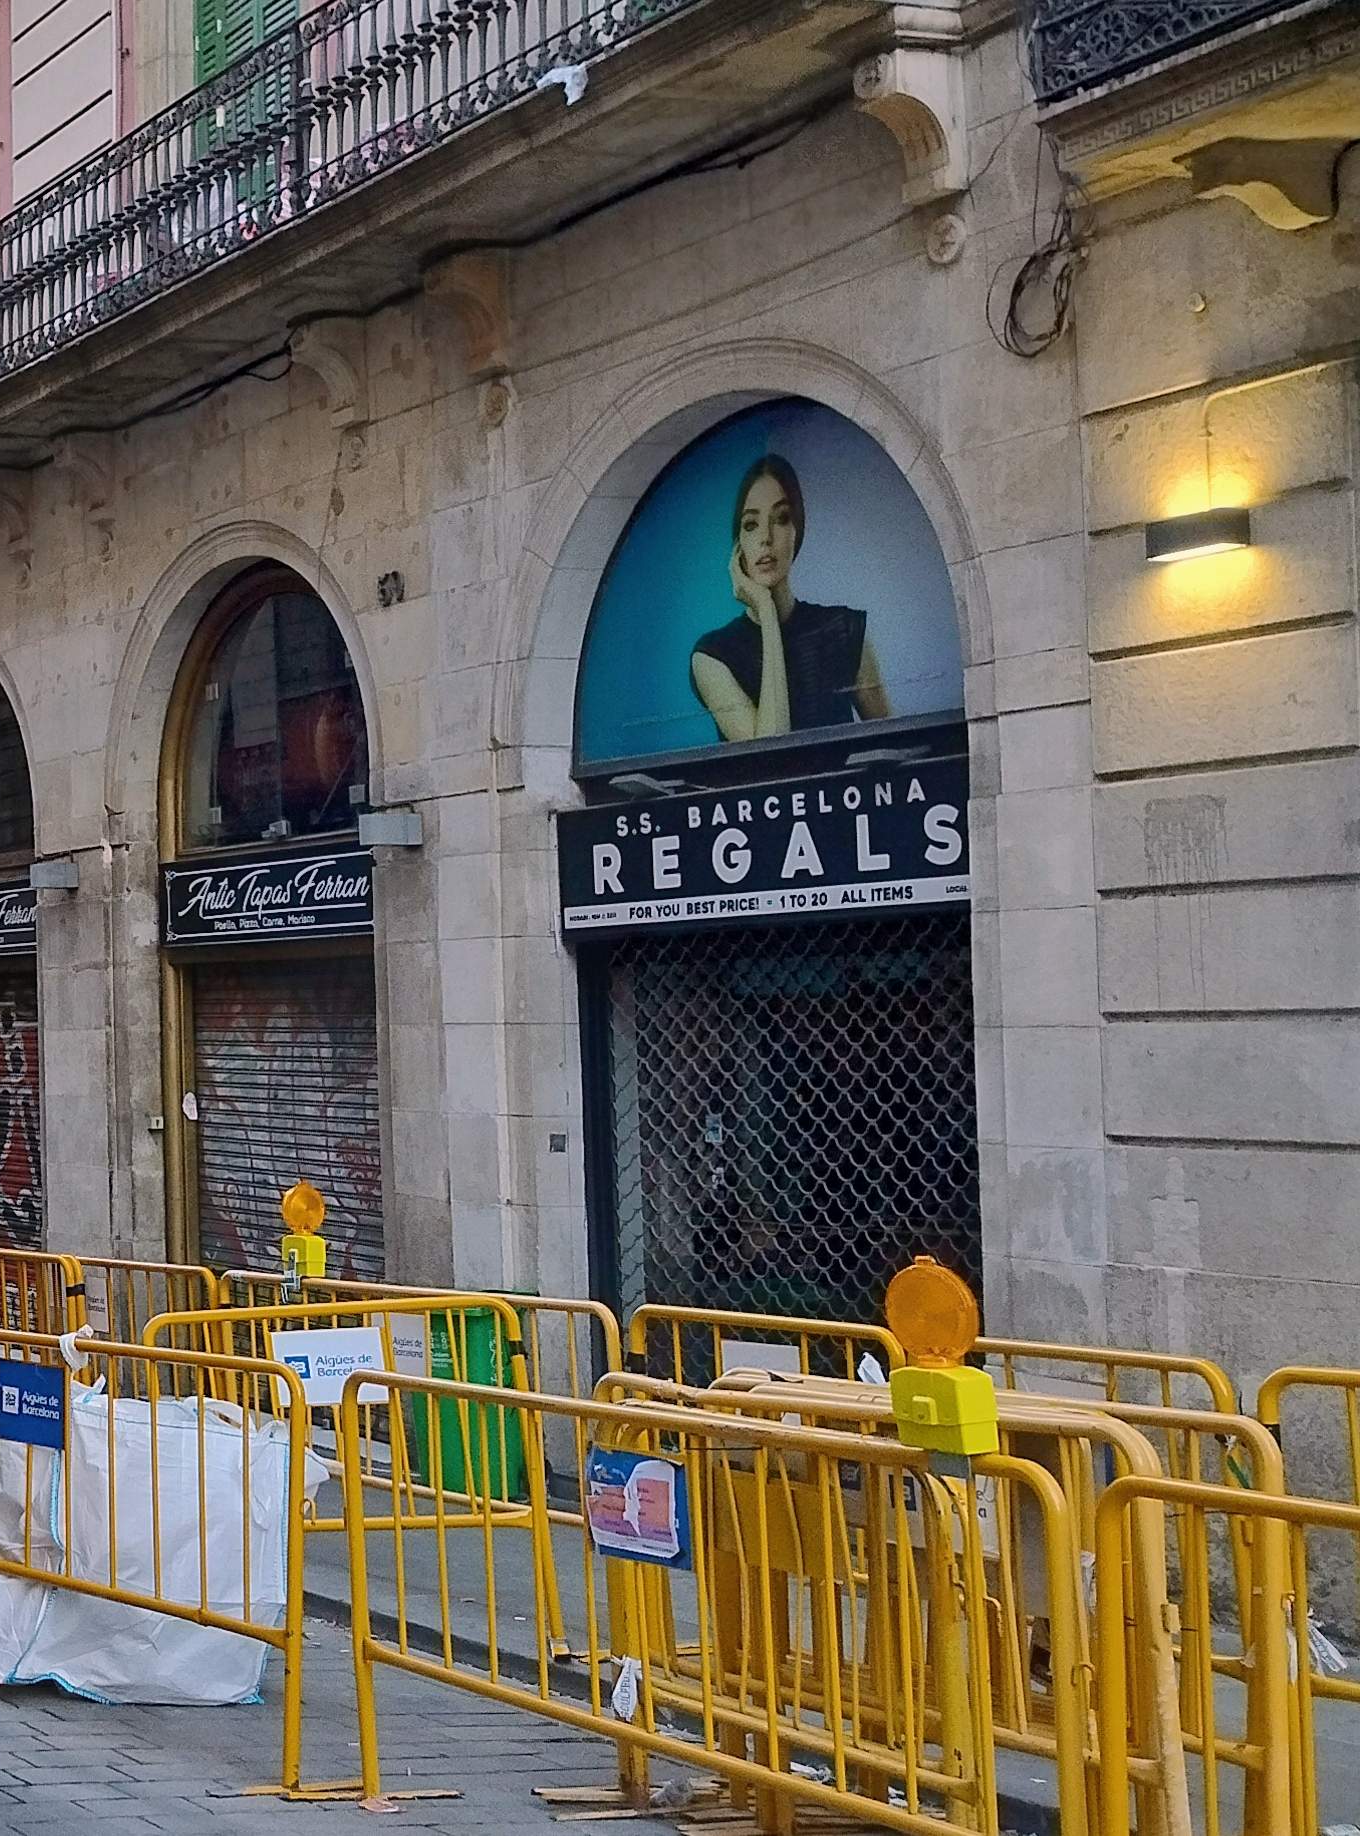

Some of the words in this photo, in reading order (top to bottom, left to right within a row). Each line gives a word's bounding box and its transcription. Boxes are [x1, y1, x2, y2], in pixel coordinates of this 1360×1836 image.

[617, 812, 661, 837] S.S.
[688, 778, 926, 828] BARCELONA
[592, 804, 962, 895] REGALS
[178, 876, 236, 919] Antic
[238, 869, 292, 920] Tapas
[295, 861, 370, 905] Ferran
[630, 906, 653, 919] FOR
[657, 904, 680, 917] YOU
[686, 901, 715, 915] BEST
[719, 898, 760, 913] PRICE!
[780, 896, 786, 908] 1
[790, 895, 807, 907] TO
[812, 893, 828, 906] 20
[841, 890, 867, 904] ALL
[871, 886, 913, 902] ITEMS
[357, 1353, 373, 1364] de
[317, 1366, 362, 1377] Barcel
[22, 1402, 60, 1420] Barcelona
[48, 1394, 60, 1407] de
